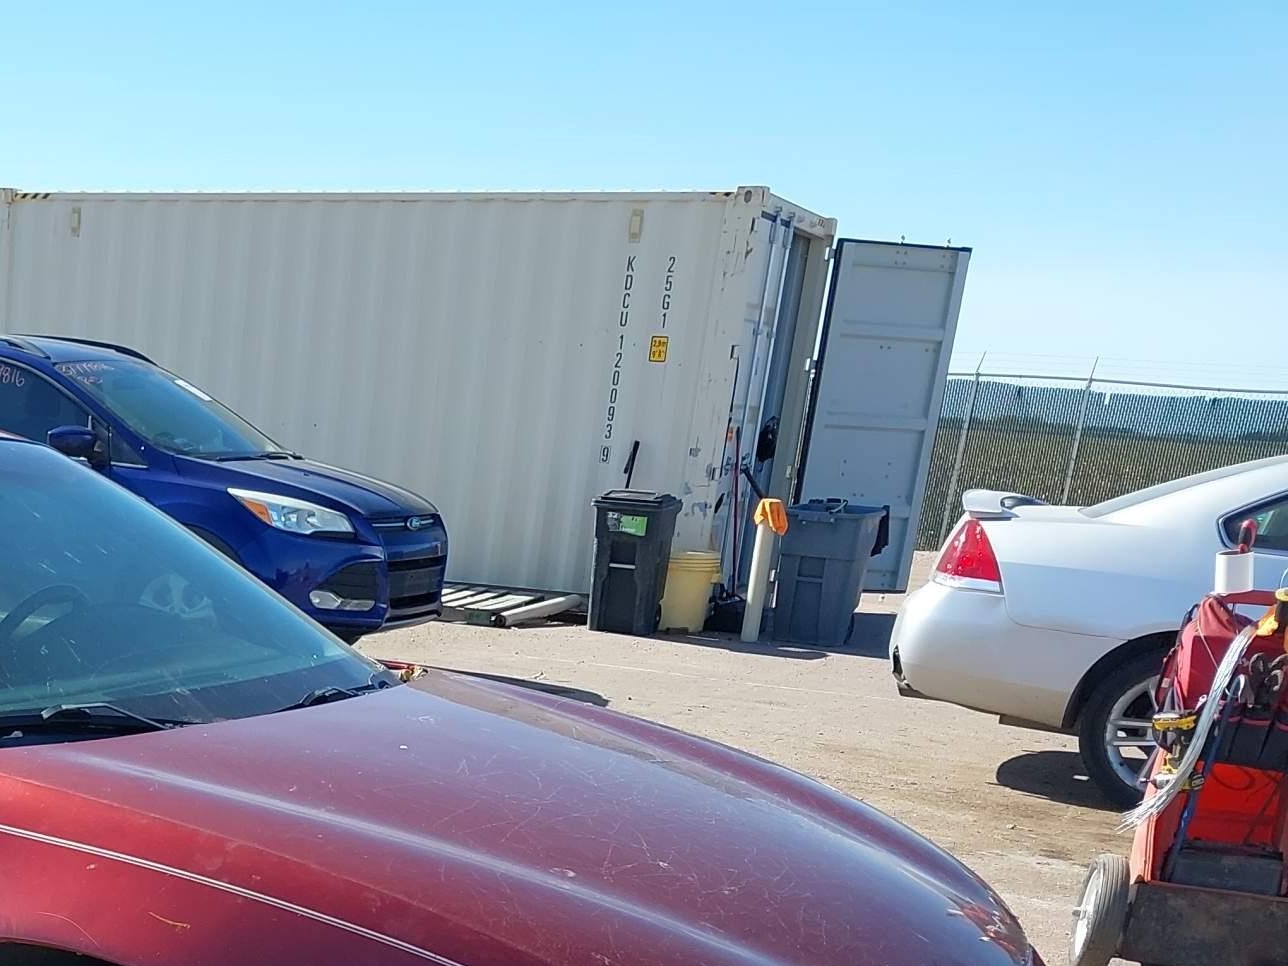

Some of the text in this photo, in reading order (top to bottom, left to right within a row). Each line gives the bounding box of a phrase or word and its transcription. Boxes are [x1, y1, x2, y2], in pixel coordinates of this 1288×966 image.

[619, 255, 637, 328] KDCU
[661, 256, 676, 329] 25G1
[604, 334, 625, 440] 120093
